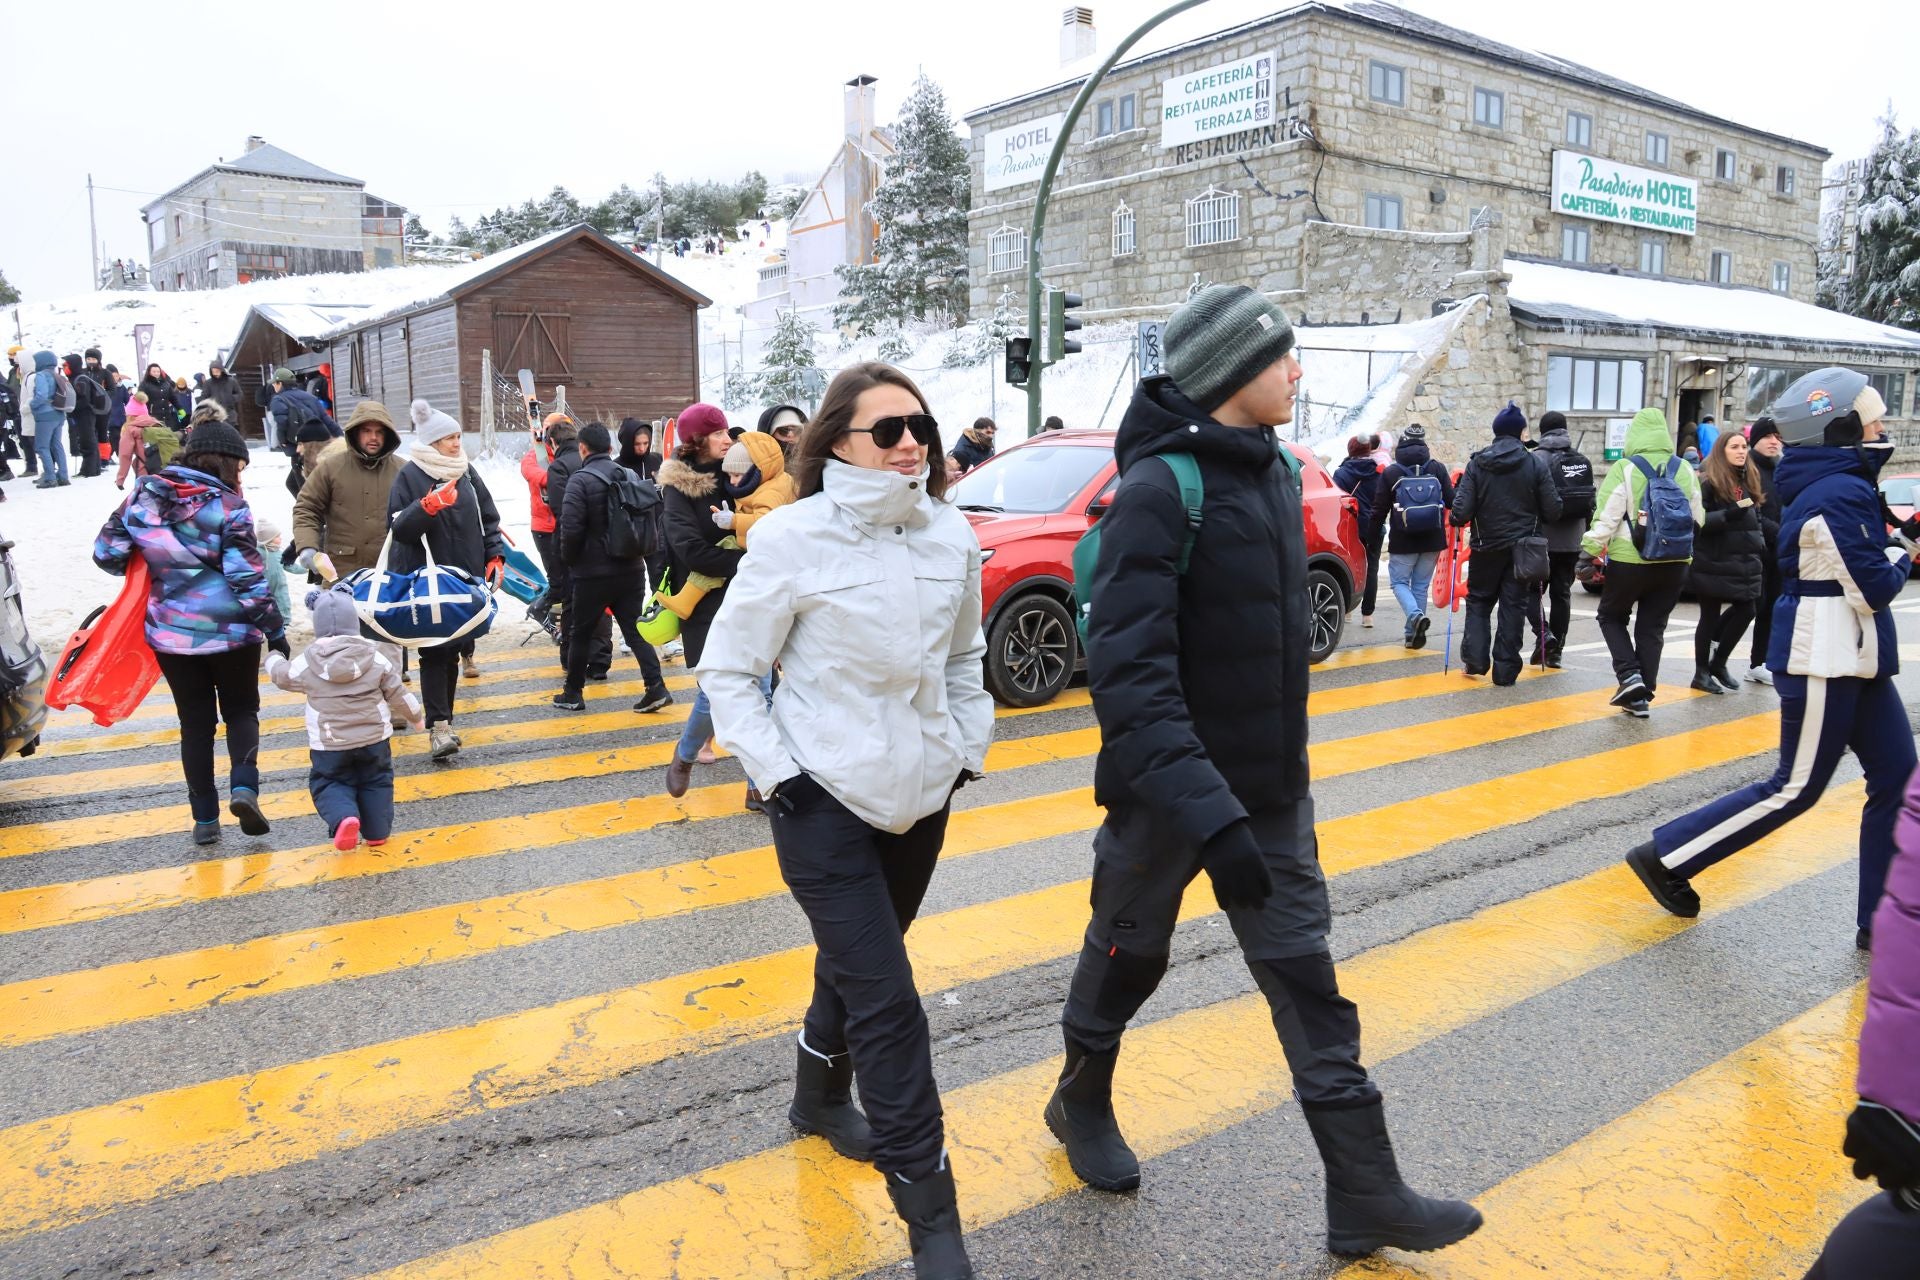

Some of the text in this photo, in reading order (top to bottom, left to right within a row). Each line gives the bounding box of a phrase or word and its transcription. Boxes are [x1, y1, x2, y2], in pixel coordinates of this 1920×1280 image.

[1184, 63, 1254, 94] CAFETERÍA
[1165, 86, 1254, 119] RESTAURANTE
[1194, 107, 1253, 132] TERRAZA
[1005, 127, 1053, 153] HOTEL
[1176, 115, 1300, 165] RESTAURANTE
[1577, 157, 1696, 211] Pasadoiro HOTEL
[1560, 193, 1695, 232] CAFETERÍA RESTAURANTE
[1561, 463, 1588, 471] Reebok
